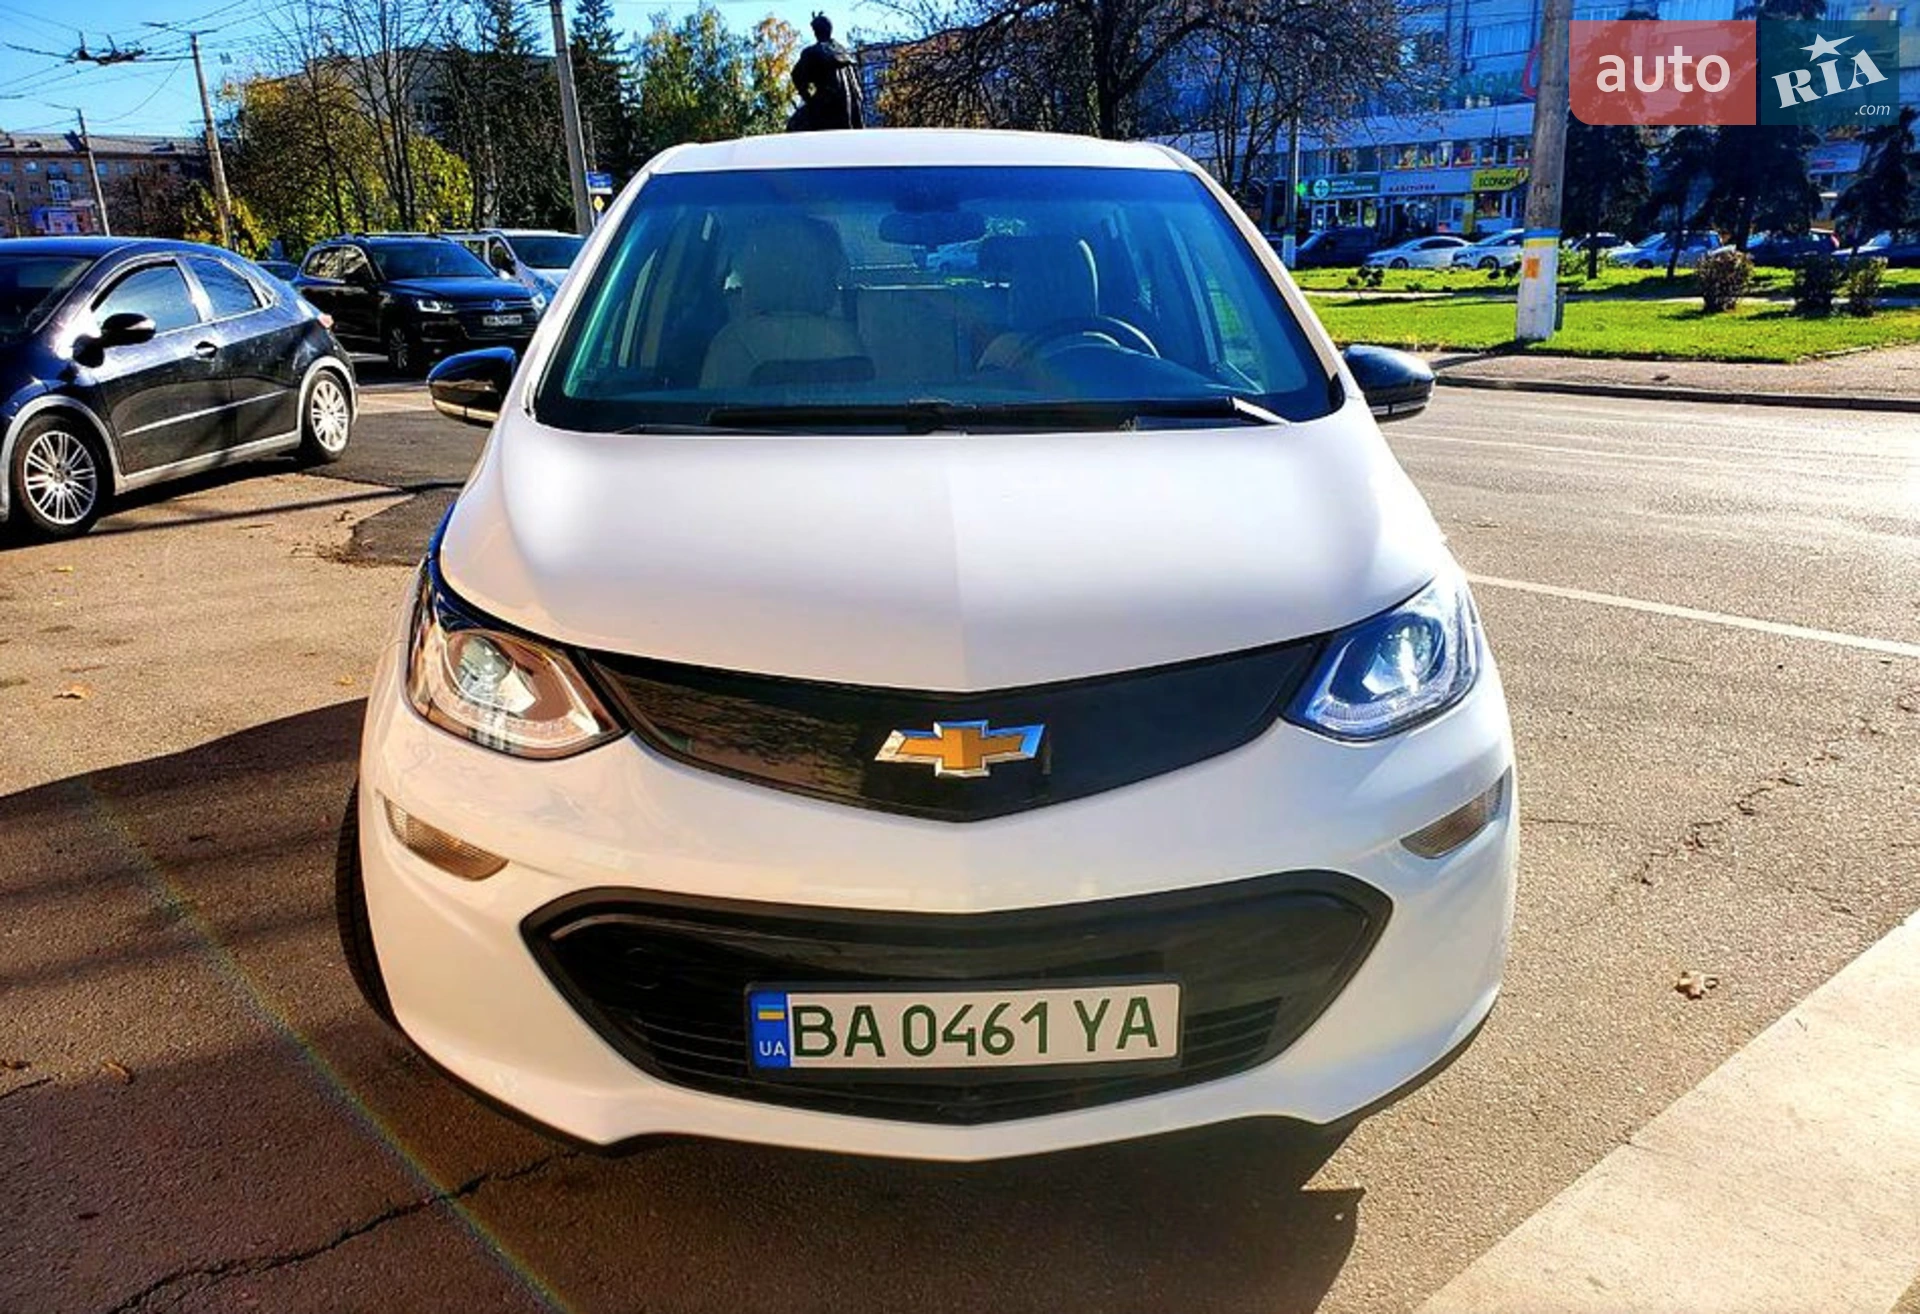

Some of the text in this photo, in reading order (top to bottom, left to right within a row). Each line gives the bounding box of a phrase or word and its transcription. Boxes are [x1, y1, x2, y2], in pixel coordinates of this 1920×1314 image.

[792, 996, 1159, 1058] BA 0461 YA
[760, 1041, 786, 1056] UA
